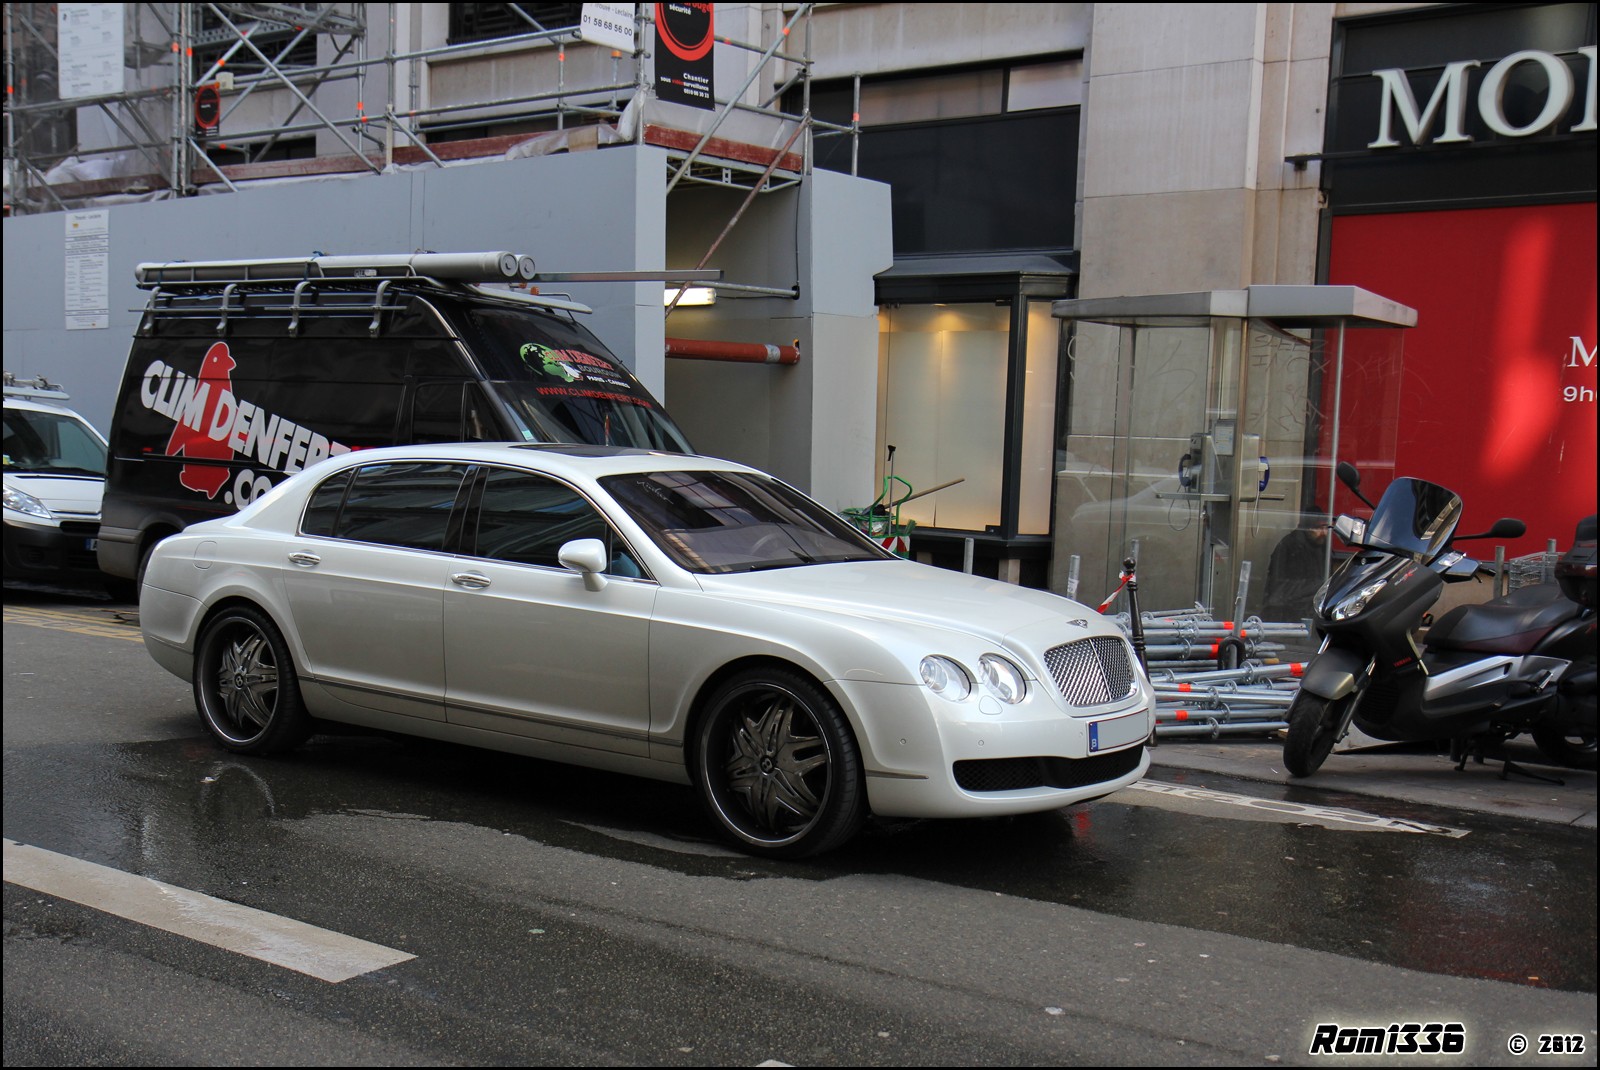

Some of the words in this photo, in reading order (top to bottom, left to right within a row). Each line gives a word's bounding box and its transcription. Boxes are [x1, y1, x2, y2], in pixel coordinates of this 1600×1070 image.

[669, 4, 692, 15] sécurité
[583, 14, 591, 23] 01
[593, 18, 603, 27] 58
[603, 21, 613, 31] 68
[613, 24, 623, 34] 56
[624, 27, 633, 37] 00
[683, 72, 709, 84] Chantier
[1367, 45, 1597, 149] MO
[141, 360, 210, 432] CLIM
[1563, 386, 1597, 402] 9h
